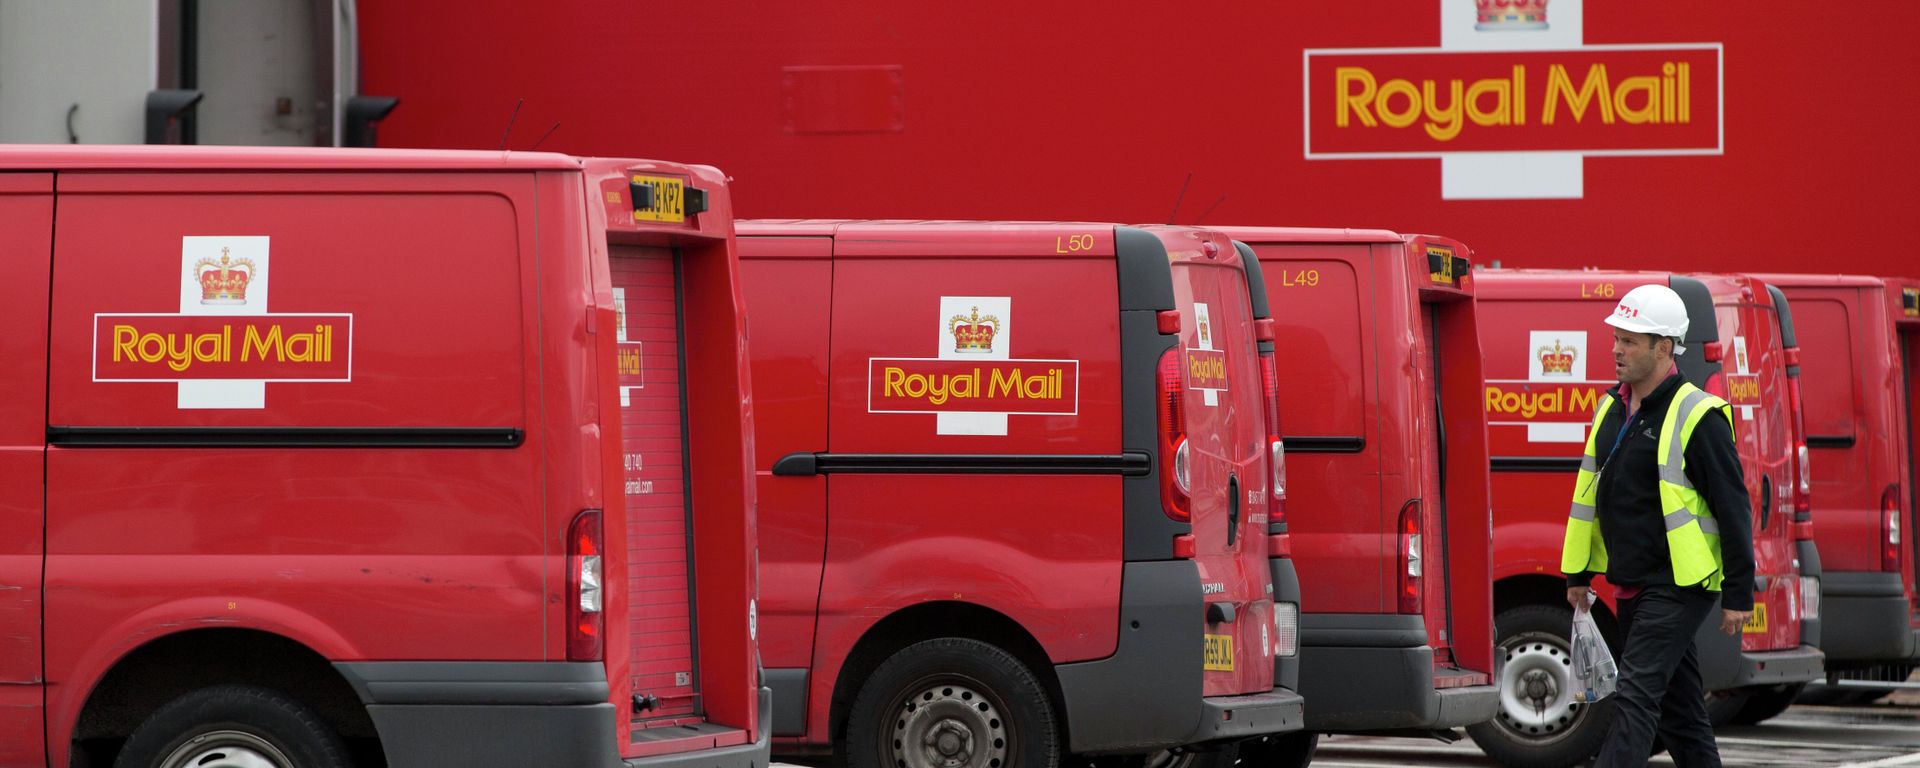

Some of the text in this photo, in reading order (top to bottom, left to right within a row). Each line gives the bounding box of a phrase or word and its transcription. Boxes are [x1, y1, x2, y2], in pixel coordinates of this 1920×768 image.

[1335, 61, 1691, 141] Royal Mail
[662, 182, 681, 214] KPZ
[1057, 234, 1094, 254] L50
[1282, 269, 1320, 287] L49
[113, 324, 332, 371] Royal Mail
[884, 367, 1062, 405] Royal Mail
[1485, 387, 1563, 418] Royal
